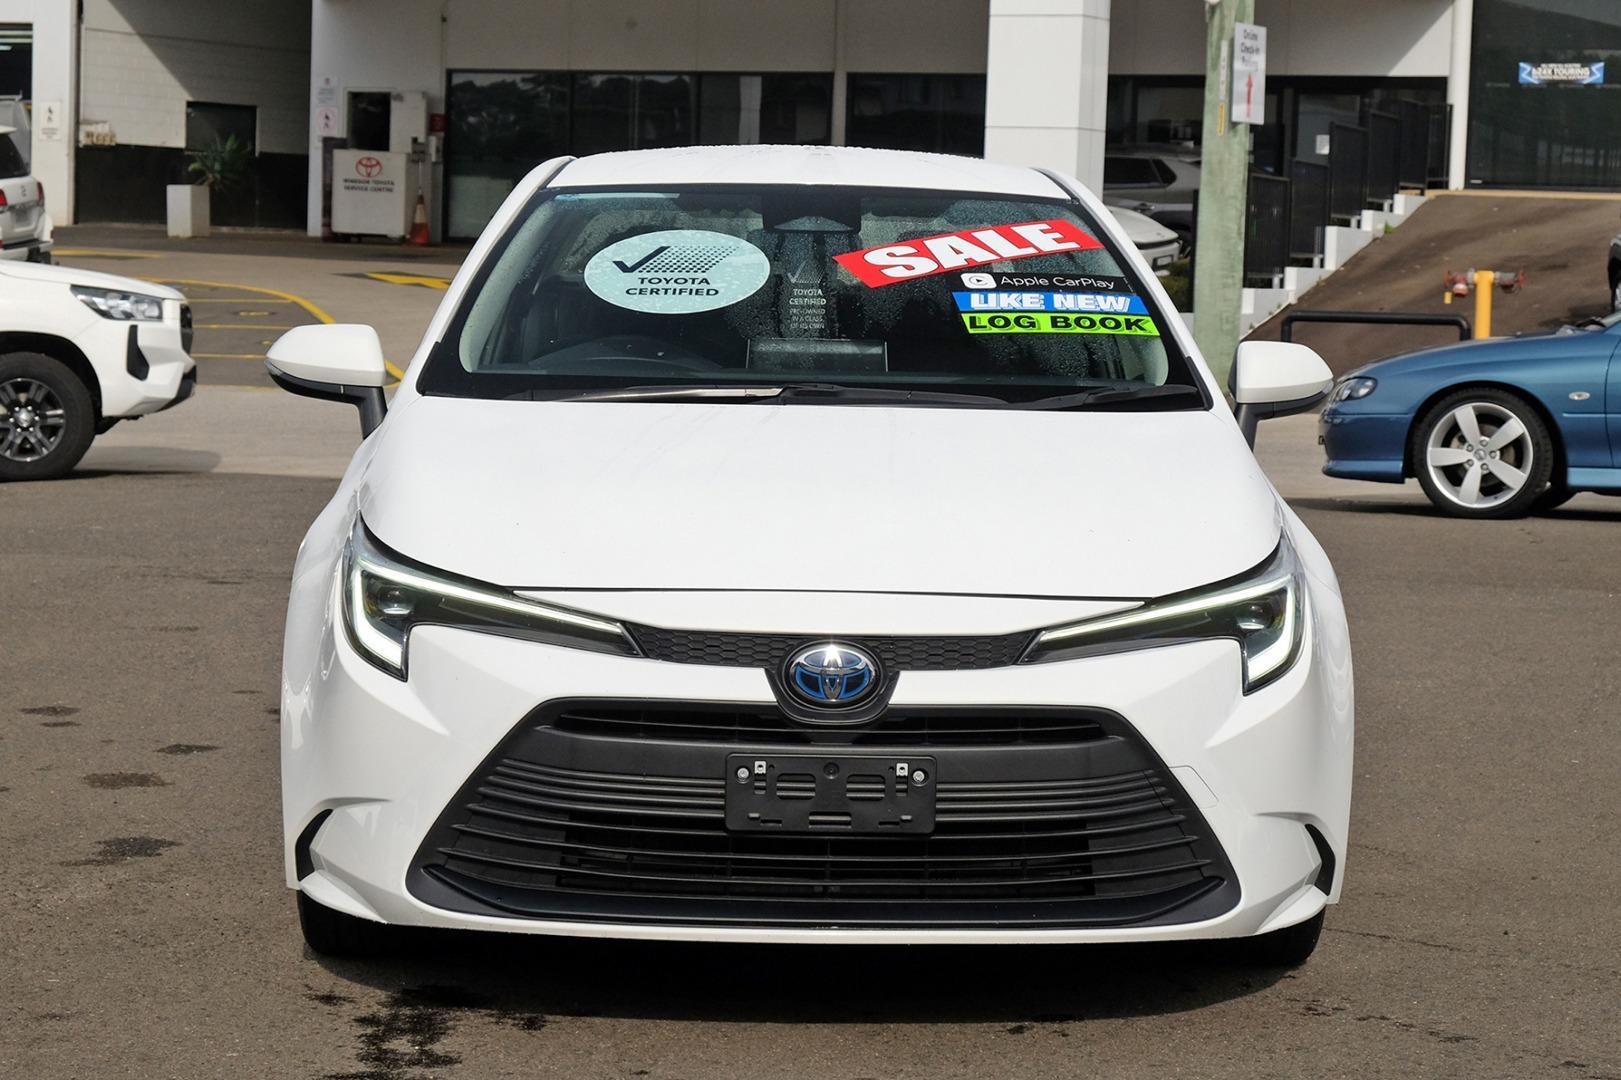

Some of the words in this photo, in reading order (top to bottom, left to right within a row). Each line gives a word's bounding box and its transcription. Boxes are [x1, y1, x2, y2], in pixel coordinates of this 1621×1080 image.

[864, 223, 1081, 279] SALE
[638, 277, 711, 285] TOYOTA
[1000, 276, 1049, 287] Apple
[1053, 277, 1115, 290] CarPlay
[626, 288, 719, 296] CERTIFIED
[970, 293, 1045, 311] LIKE
[1053, 293, 1130, 312] NEW
[969, 314, 1041, 330] LOG
[1050, 315, 1153, 332] BOOK
